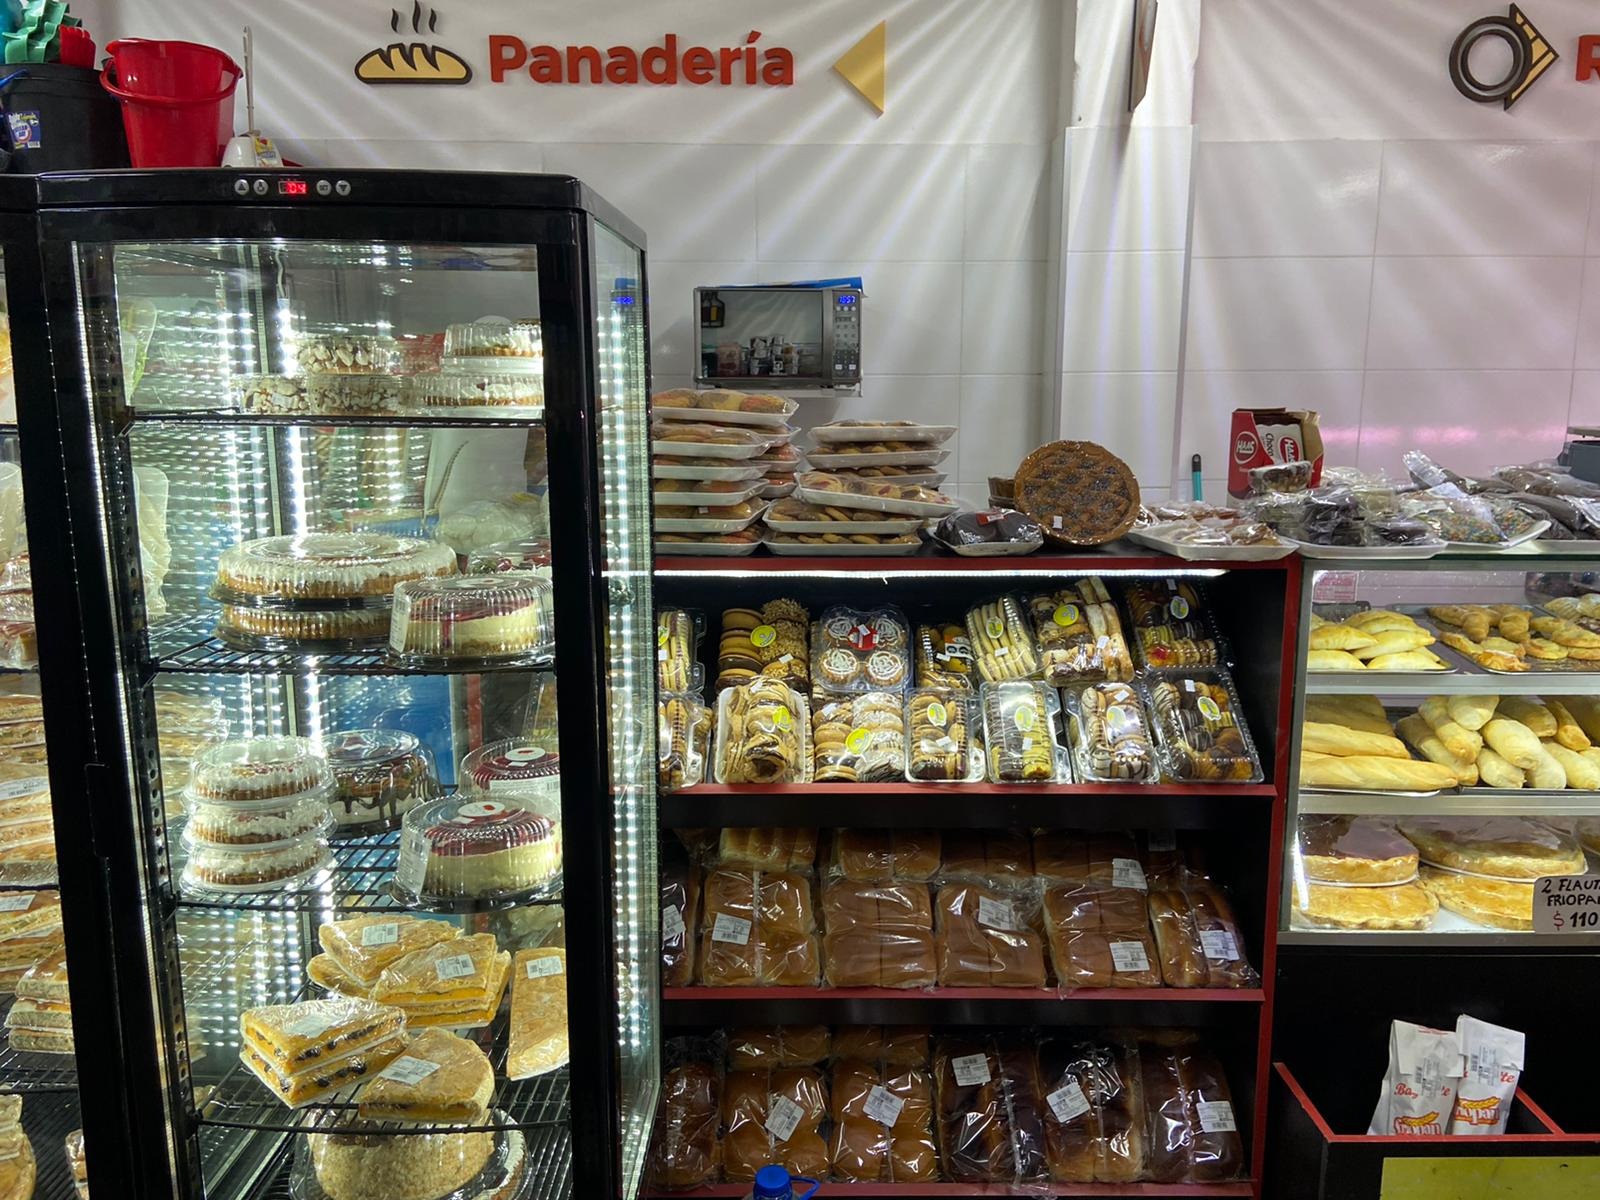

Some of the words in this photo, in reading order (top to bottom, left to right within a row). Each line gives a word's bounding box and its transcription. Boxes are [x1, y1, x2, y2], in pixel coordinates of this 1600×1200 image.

[489, 30, 794, 85] Panadería
[1236, 440, 1255, 454] HAAS
[1541, 878, 1552, 894] 2
[1558, 878, 1600, 892] FLAUT
[1570, 911, 1599, 928] 110
